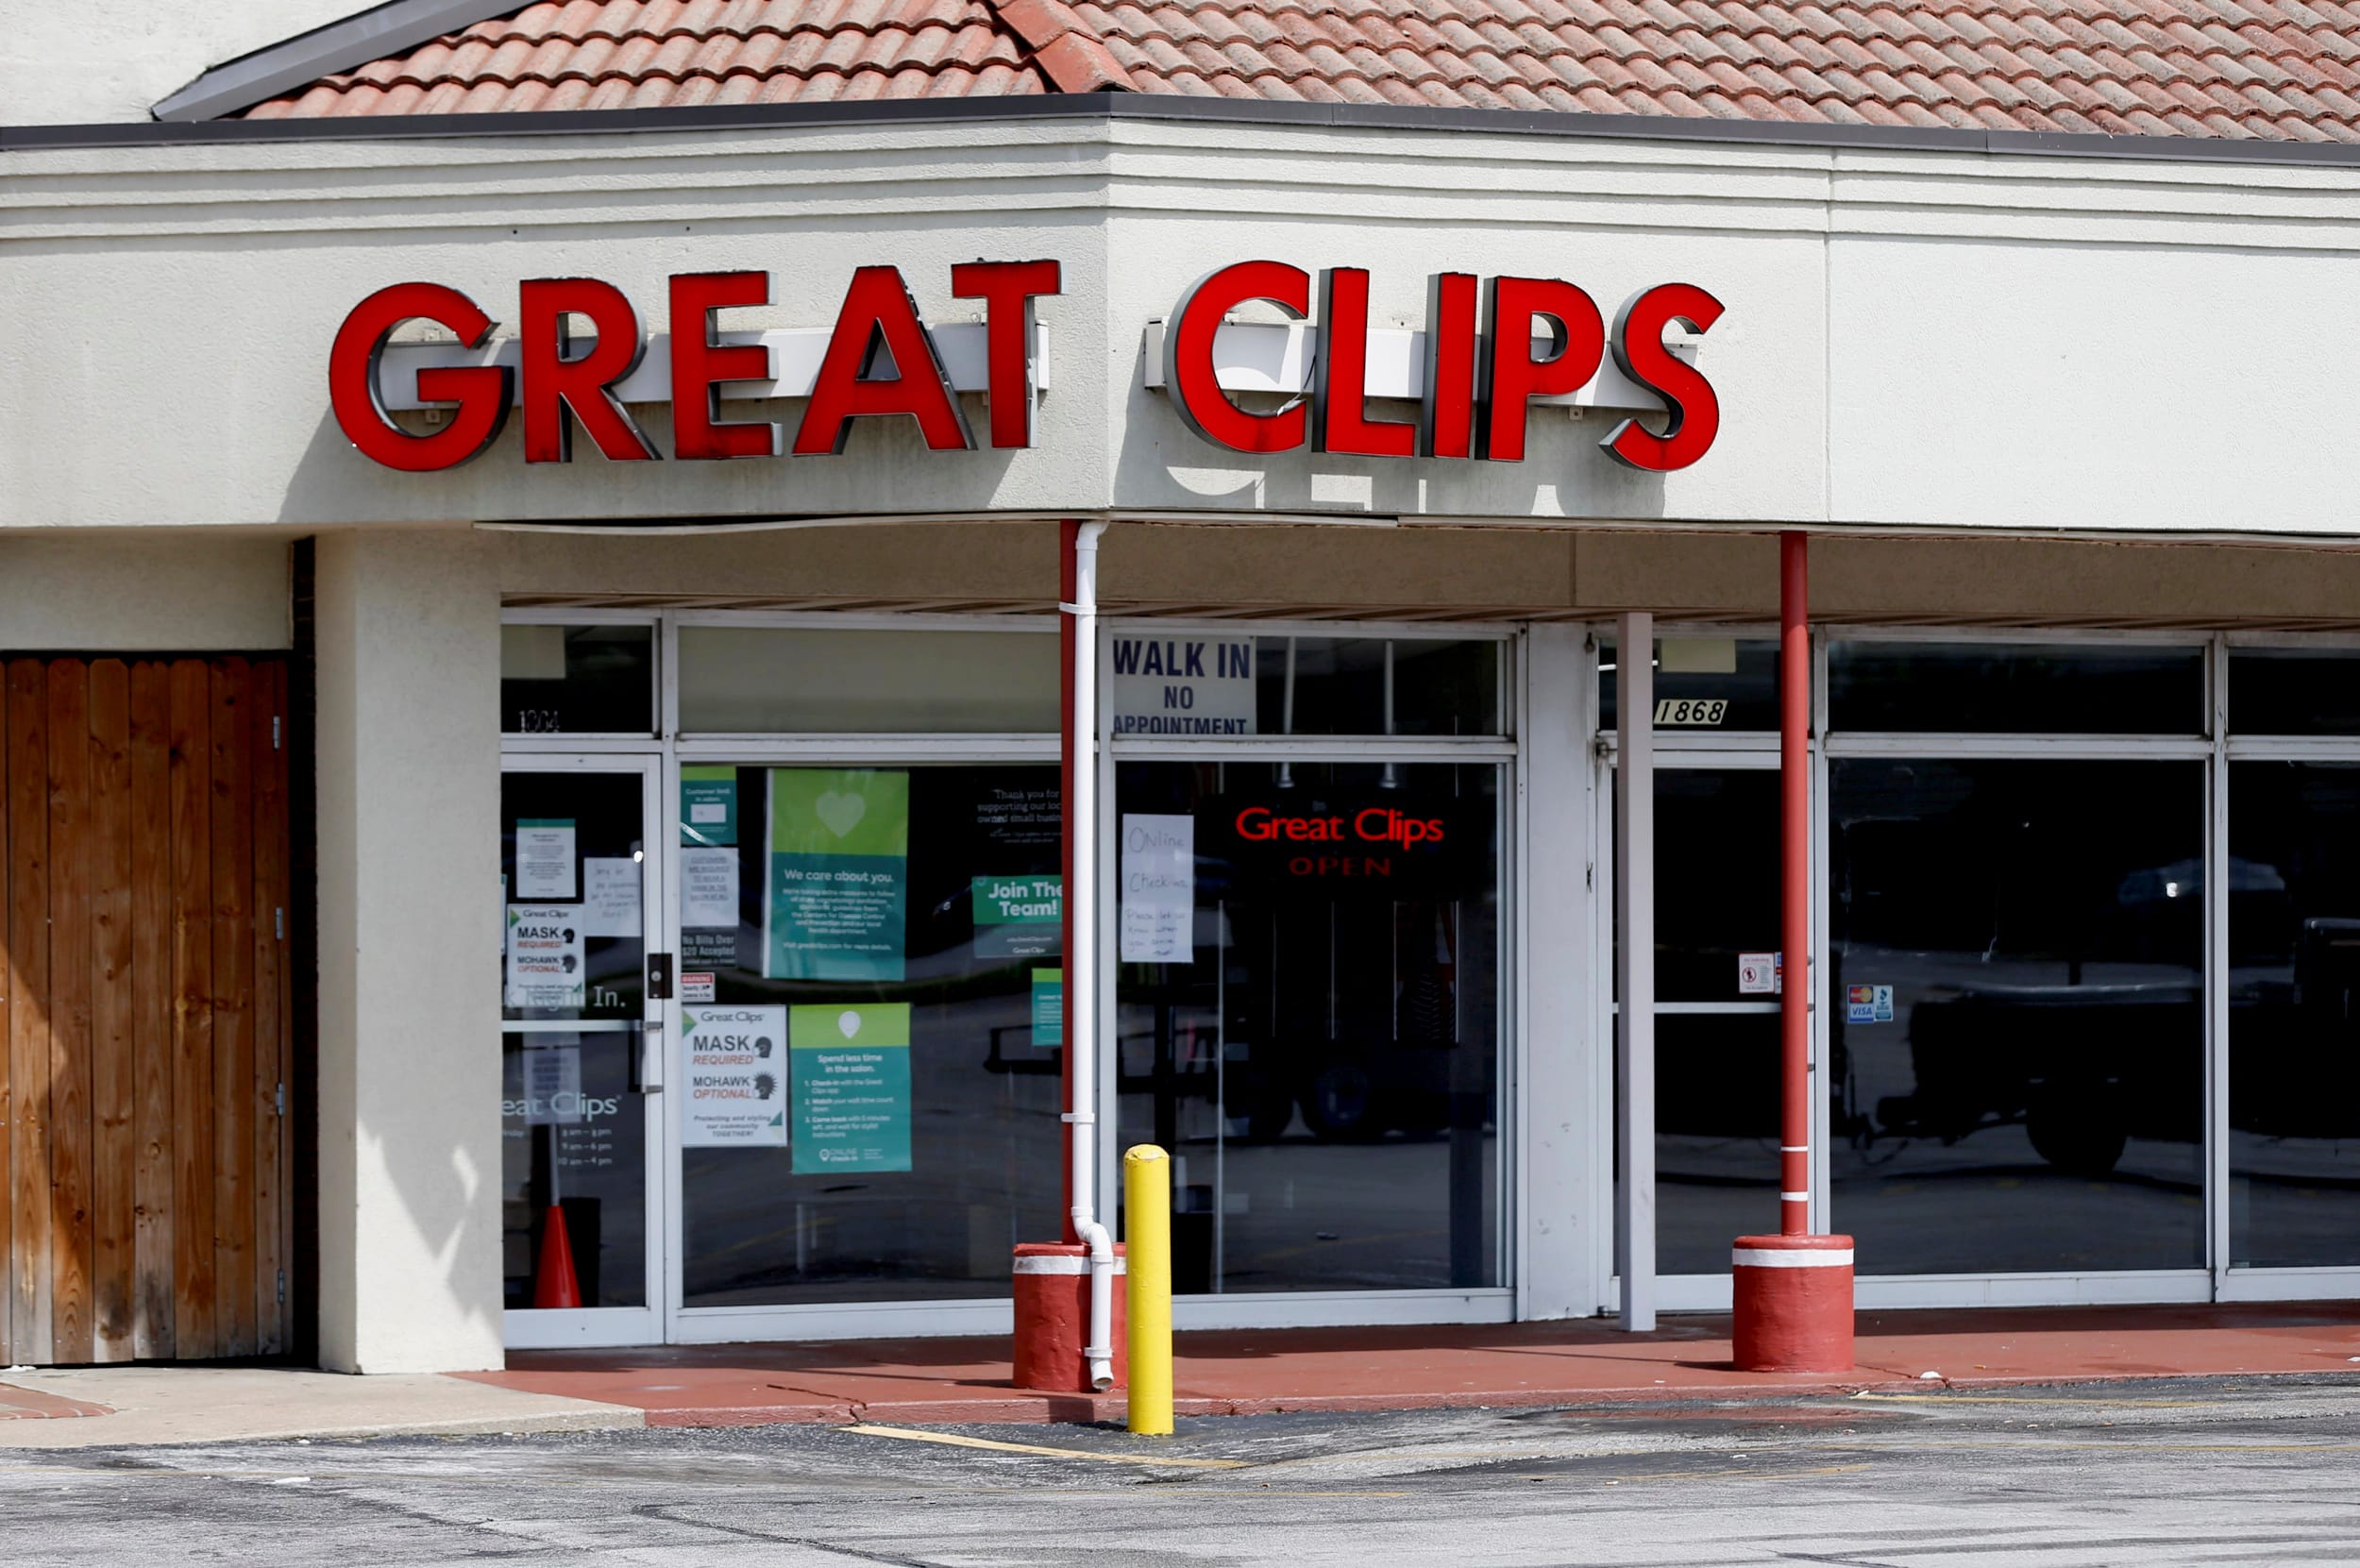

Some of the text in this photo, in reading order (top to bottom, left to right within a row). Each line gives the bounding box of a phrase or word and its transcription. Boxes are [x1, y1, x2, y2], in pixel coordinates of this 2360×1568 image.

[329, 260, 1067, 472] GREAT
[1167, 260, 1726, 471] CLIPS
[1113, 639, 1250, 680] WALK IN
[1164, 685, 1194, 709] NO
[1660, 700, 1724, 722] 1868
[1113, 716, 1247, 734] APPOINTMENT
[1026, 791, 1044, 801] you
[1046, 788, 1059, 799] for
[1235, 805, 1444, 851] Great Clips
[1288, 855, 1391, 877] OPEN
[784, 868, 894, 885] We care about you.
[988, 881, 1029, 899] Join
[523, 909, 547, 919] Great
[999, 899, 1058, 917] Team!
[516, 926, 560, 939] MASK
[516, 940, 562, 949] REQUIRED
[516, 955, 560, 964] MOHAWK
[516, 965, 560, 973] OPTIONAL
[593, 986, 626, 1008] In.
[700, 1010, 764, 1024] Great Clips
[1852, 1006, 1873, 1015] VISA
[693, 1035, 750, 1052] MASK
[692, 1054, 753, 1065] REQUIRED
[818, 1054, 845, 1064] Spend
[862, 1054, 883, 1062] time
[693, 1076, 750, 1087] MOHAWK
[693, 1088, 752, 1100] OPTIONAL
[502, 1091, 618, 1122] eat Clips
